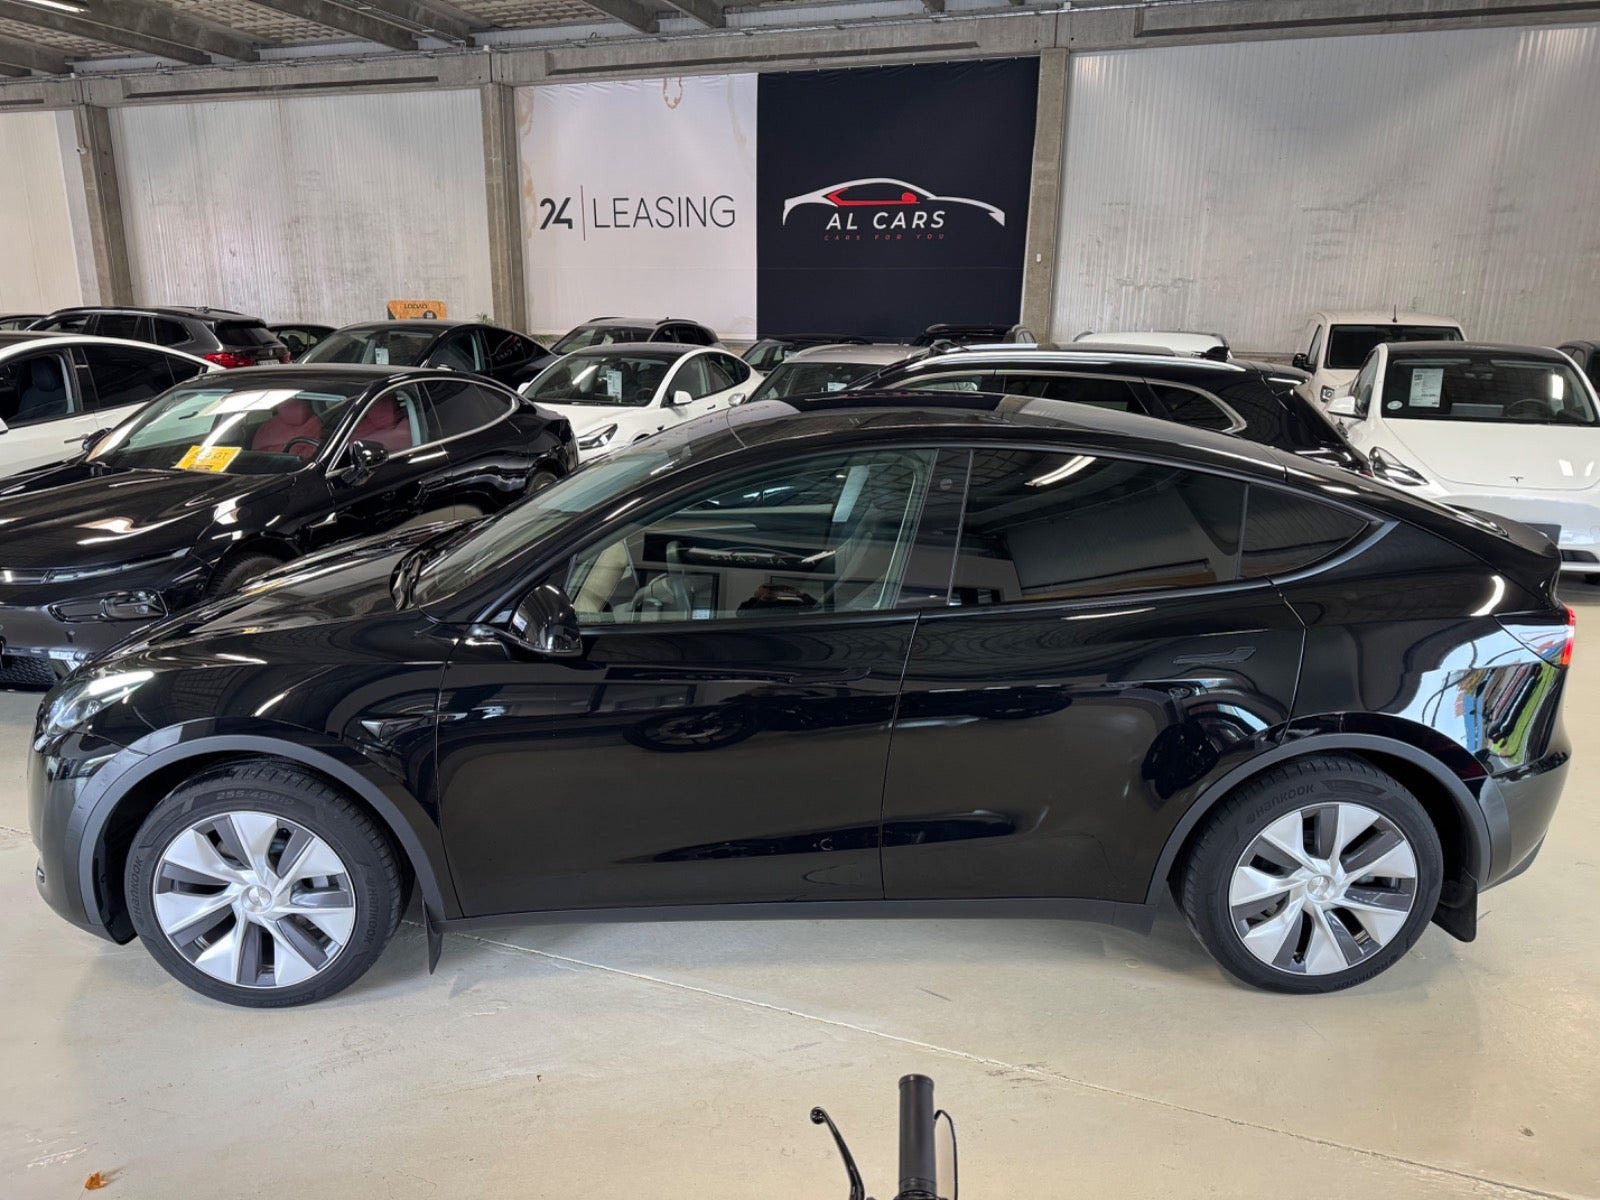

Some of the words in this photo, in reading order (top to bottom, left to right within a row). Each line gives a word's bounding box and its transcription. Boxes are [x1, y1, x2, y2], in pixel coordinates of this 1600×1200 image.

[539, 196, 573, 230] 24
[593, 194, 736, 229] LEASING
[825, 212, 858, 231] AL
[872, 210, 946, 230] CARS
[874, 233, 902, 241] FOR
